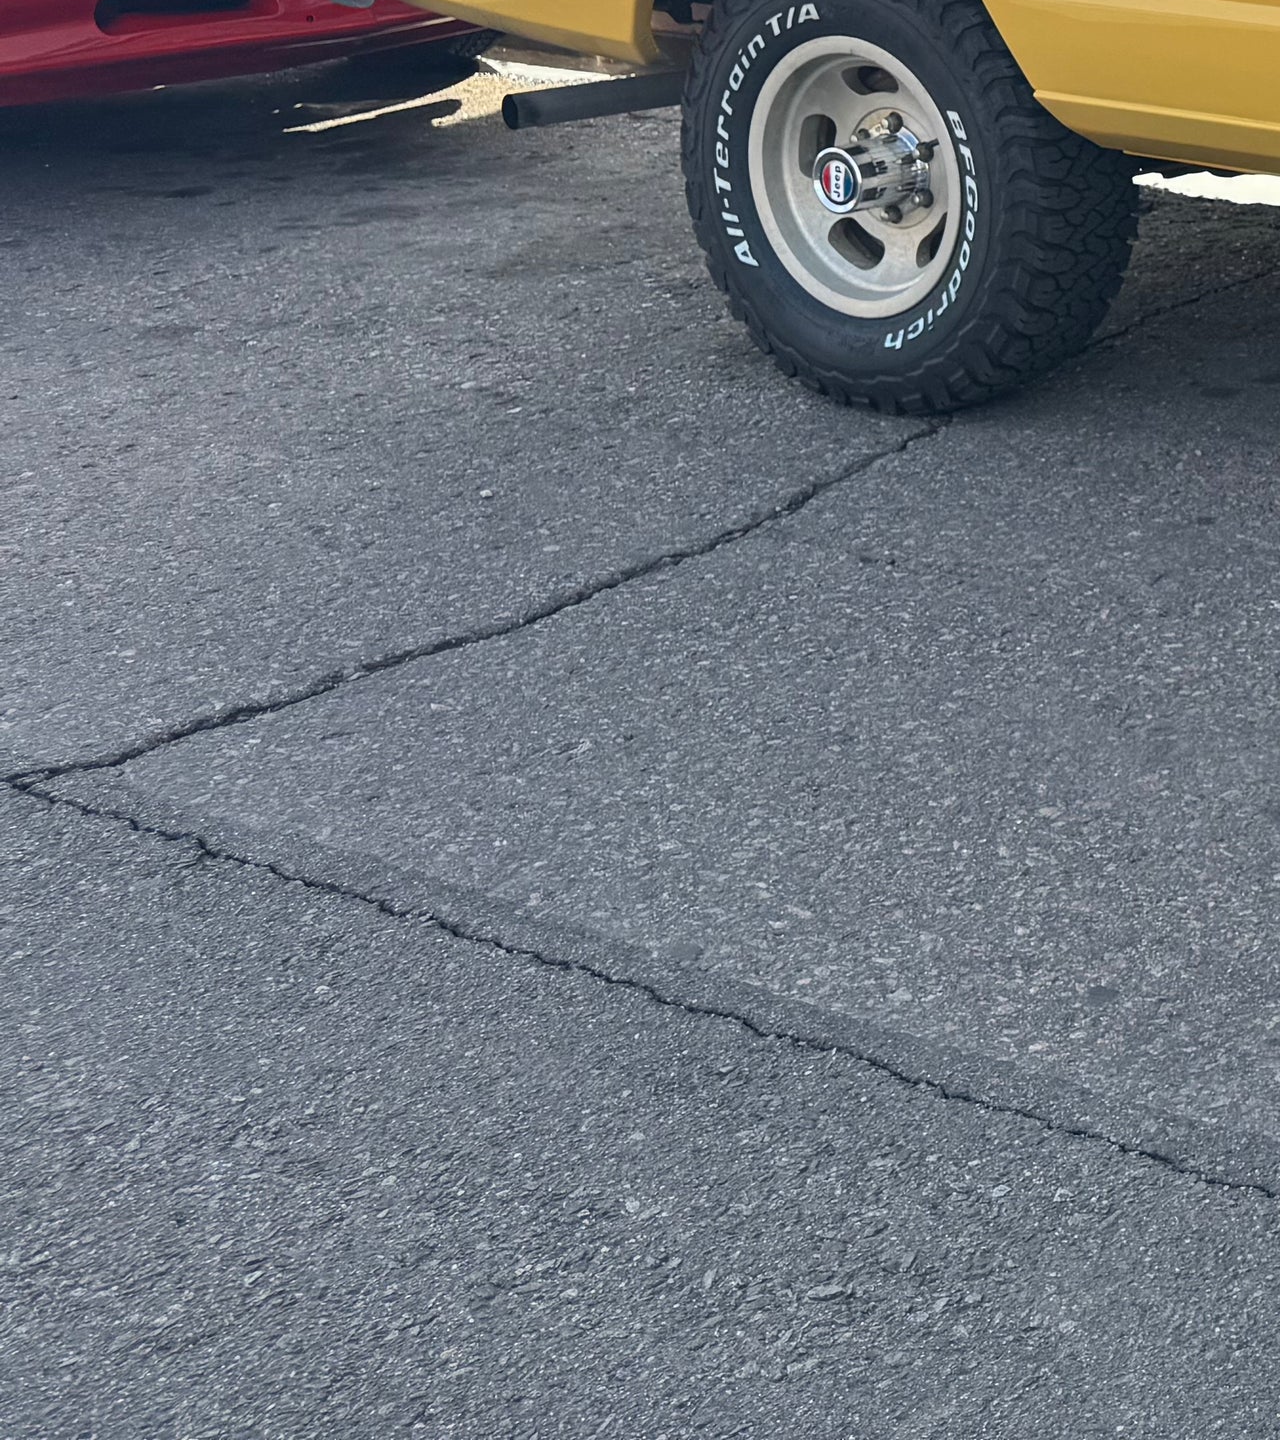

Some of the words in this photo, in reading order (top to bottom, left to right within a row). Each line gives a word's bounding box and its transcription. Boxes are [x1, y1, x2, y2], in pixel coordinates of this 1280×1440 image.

[764, 1, 820, 38] T/A
[713, 35, 766, 268] All-Terrain
[833, 165, 842, 198] Jeep
[884, 109, 980, 351] BFGoodrich
